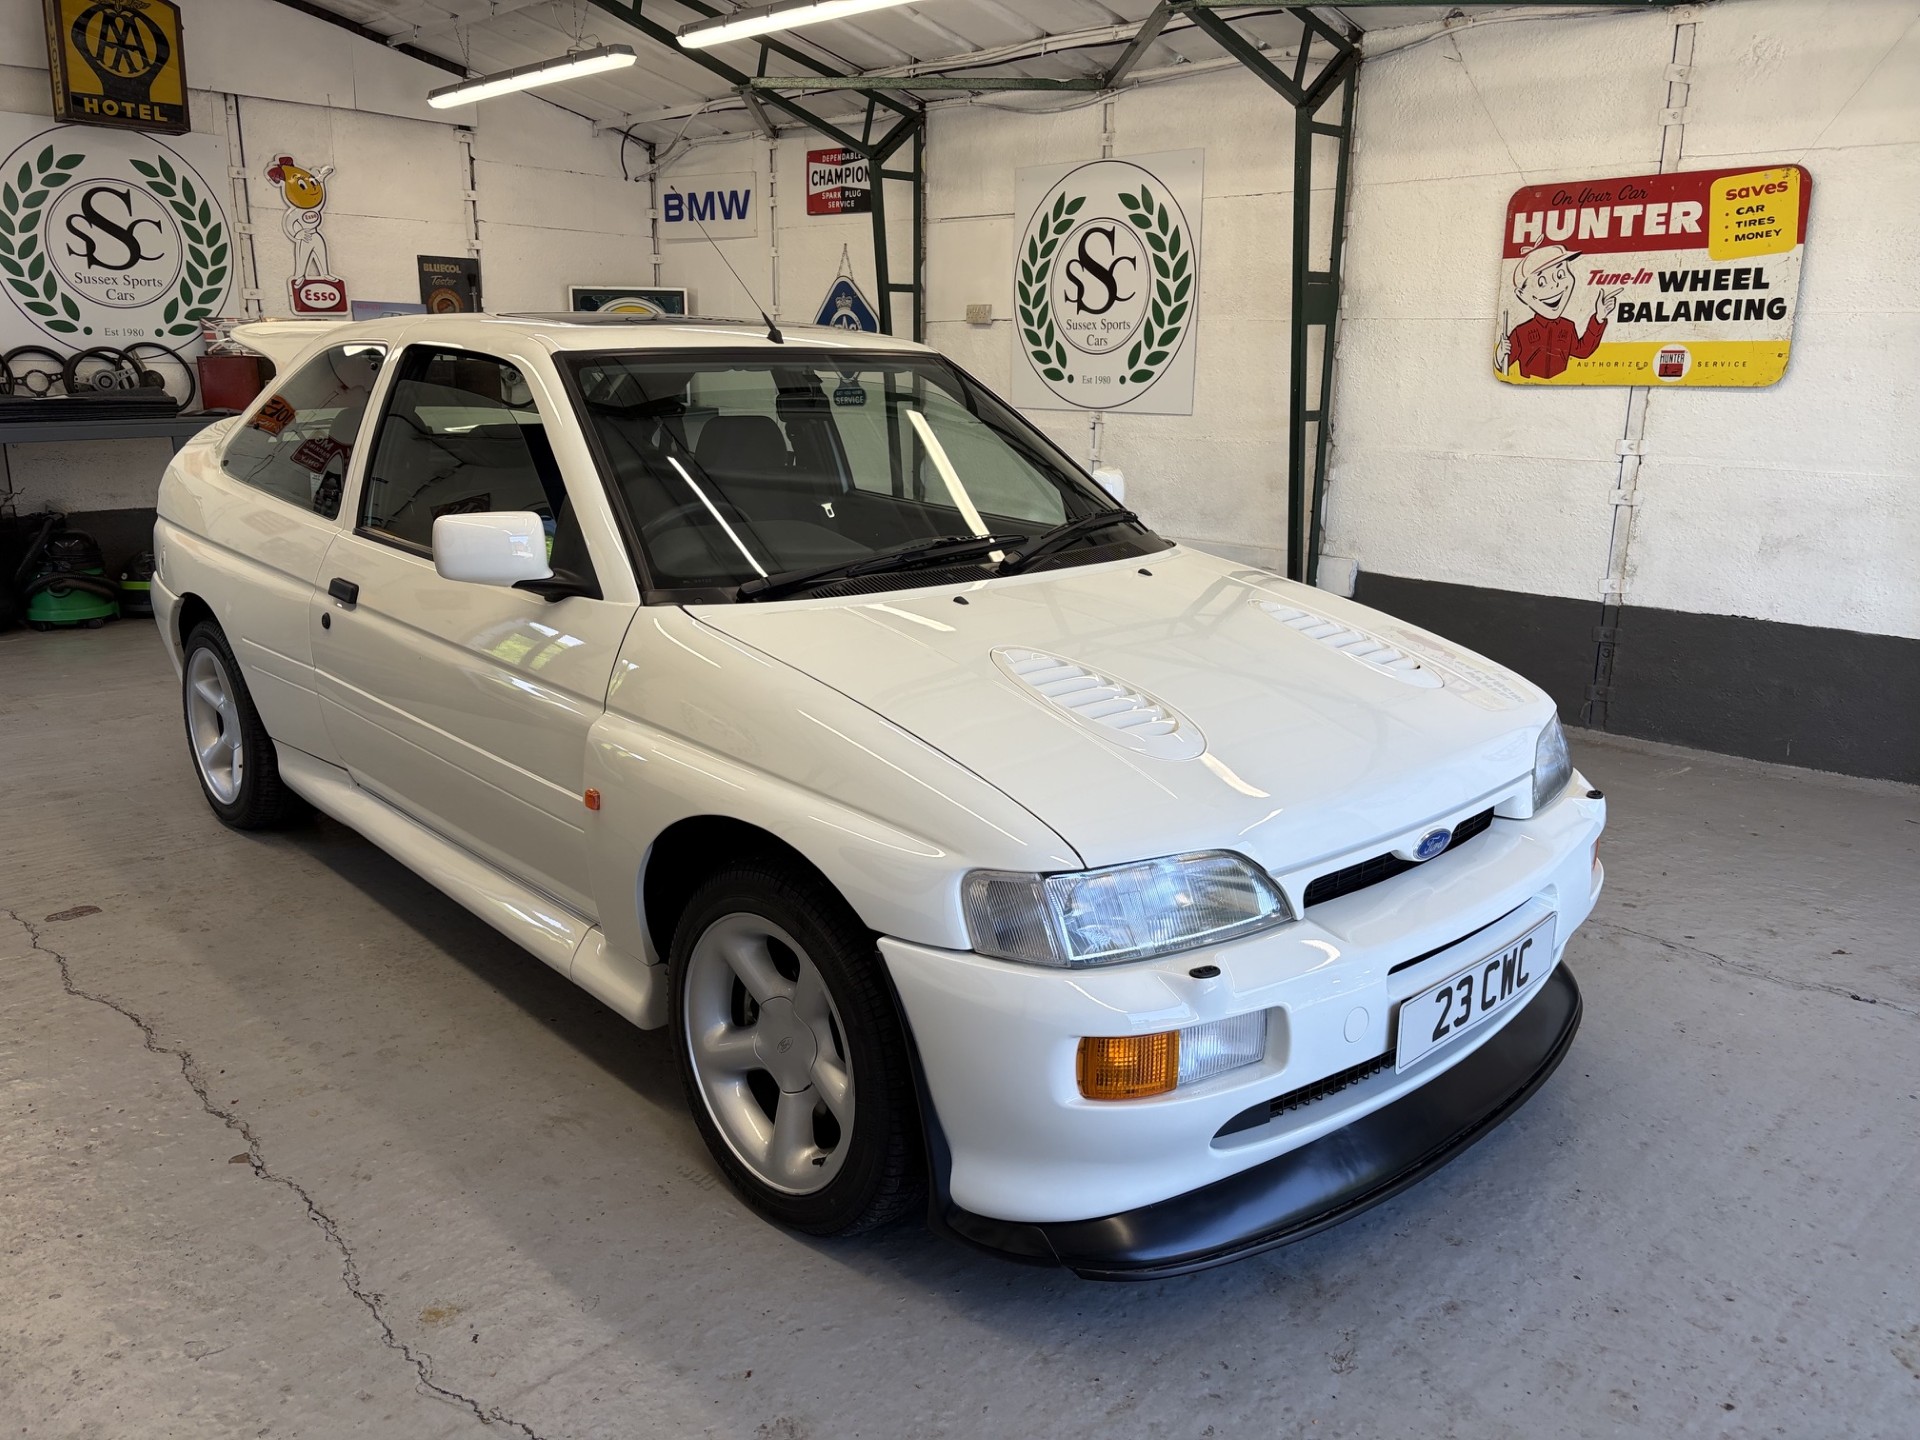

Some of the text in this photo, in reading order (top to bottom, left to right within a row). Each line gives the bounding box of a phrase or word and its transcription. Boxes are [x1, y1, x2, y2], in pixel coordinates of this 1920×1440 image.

[50, 34, 63, 111] HOTEL
[83, 97, 168, 122] HOTEL
[822, 152, 861, 163] DEPENDABLE
[822, 189, 861, 200] SPARK PLUG
[1552, 184, 1648, 209] On Your Car
[1725, 180, 1789, 201] saves
[664, 189, 750, 222] BMW
[828, 200, 855, 209] SERVICE
[1735, 204, 1765, 216] CAR
[1512, 200, 1704, 244] HUNTER
[1735, 216, 1776, 228] TIRES
[1734, 228, 1783, 242] MONEY
[423, 263, 462, 274] BLUECOL
[74, 272, 163, 289] Sussex Sports
[431, 275, 456, 286] Tester
[1587, 267, 1770, 293] Tune-In WHEEL
[106, 288, 135, 301] Cars
[304, 289, 337, 302] Esso
[1617, 297, 1787, 323] BALANCING
[104, 327, 144, 337] Est 1980
[1066, 318, 1131, 333] Sussex Sports
[1086, 334, 1108, 346] Cars
[1577, 360, 1748, 369] AUTHORIZED SERVICE
[1660, 353, 1685, 363] HUNTER
[1082, 375, 1111, 385] Est 1980
[1424, 835, 1445, 854] Ford
[1432, 937, 1533, 1042] 23 CWC
